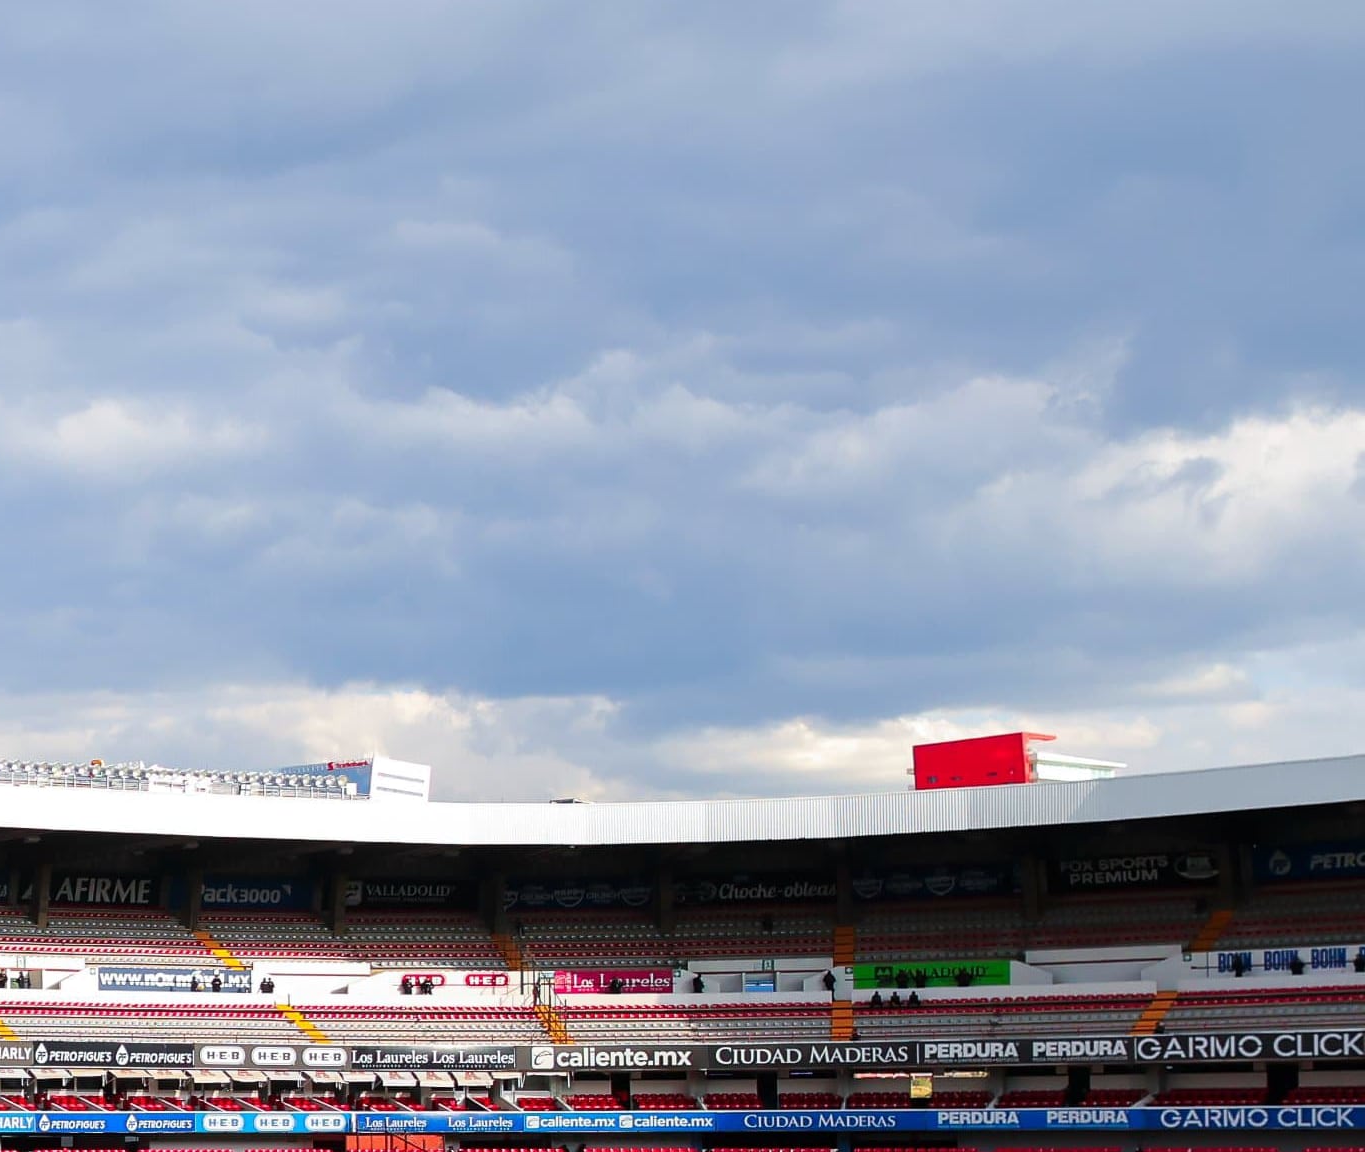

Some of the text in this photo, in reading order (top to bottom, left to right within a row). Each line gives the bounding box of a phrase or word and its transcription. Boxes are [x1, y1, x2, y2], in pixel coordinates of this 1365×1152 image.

[1099, 855, 1169, 870] SPORTS
[1069, 868, 1158, 886] PREMIUM
[56, 877, 151, 904] AFIRME
[1311, 948, 1346, 969] BOHN
[573, 974, 594, 988] Los
[924, 1043, 1018, 1059] PERDURA
[1033, 1040, 1127, 1057] PERDURA
[1137, 1032, 1364, 1059] GARMO CLICK
[352, 1051, 428, 1064] Los Laureles
[433, 1051, 514, 1064] Los Laureles
[557, 1048, 692, 1068] caliente.mx
[716, 1046, 908, 1065] CIUDAD MADERAS
[366, 1117, 427, 1128] Los Laureles
[448, 1117, 512, 1128] Los Laureles
[541, 1115, 615, 1128] caliente.mx
[634, 1115, 713, 1128] caliente.mx
[744, 1114, 896, 1128] CIUDAD MADERAS
[938, 1112, 1018, 1125] PERDURA
[1047, 1110, 1127, 1124] PERDURA
[1161, 1108, 1354, 1128] GARMO CLICK
